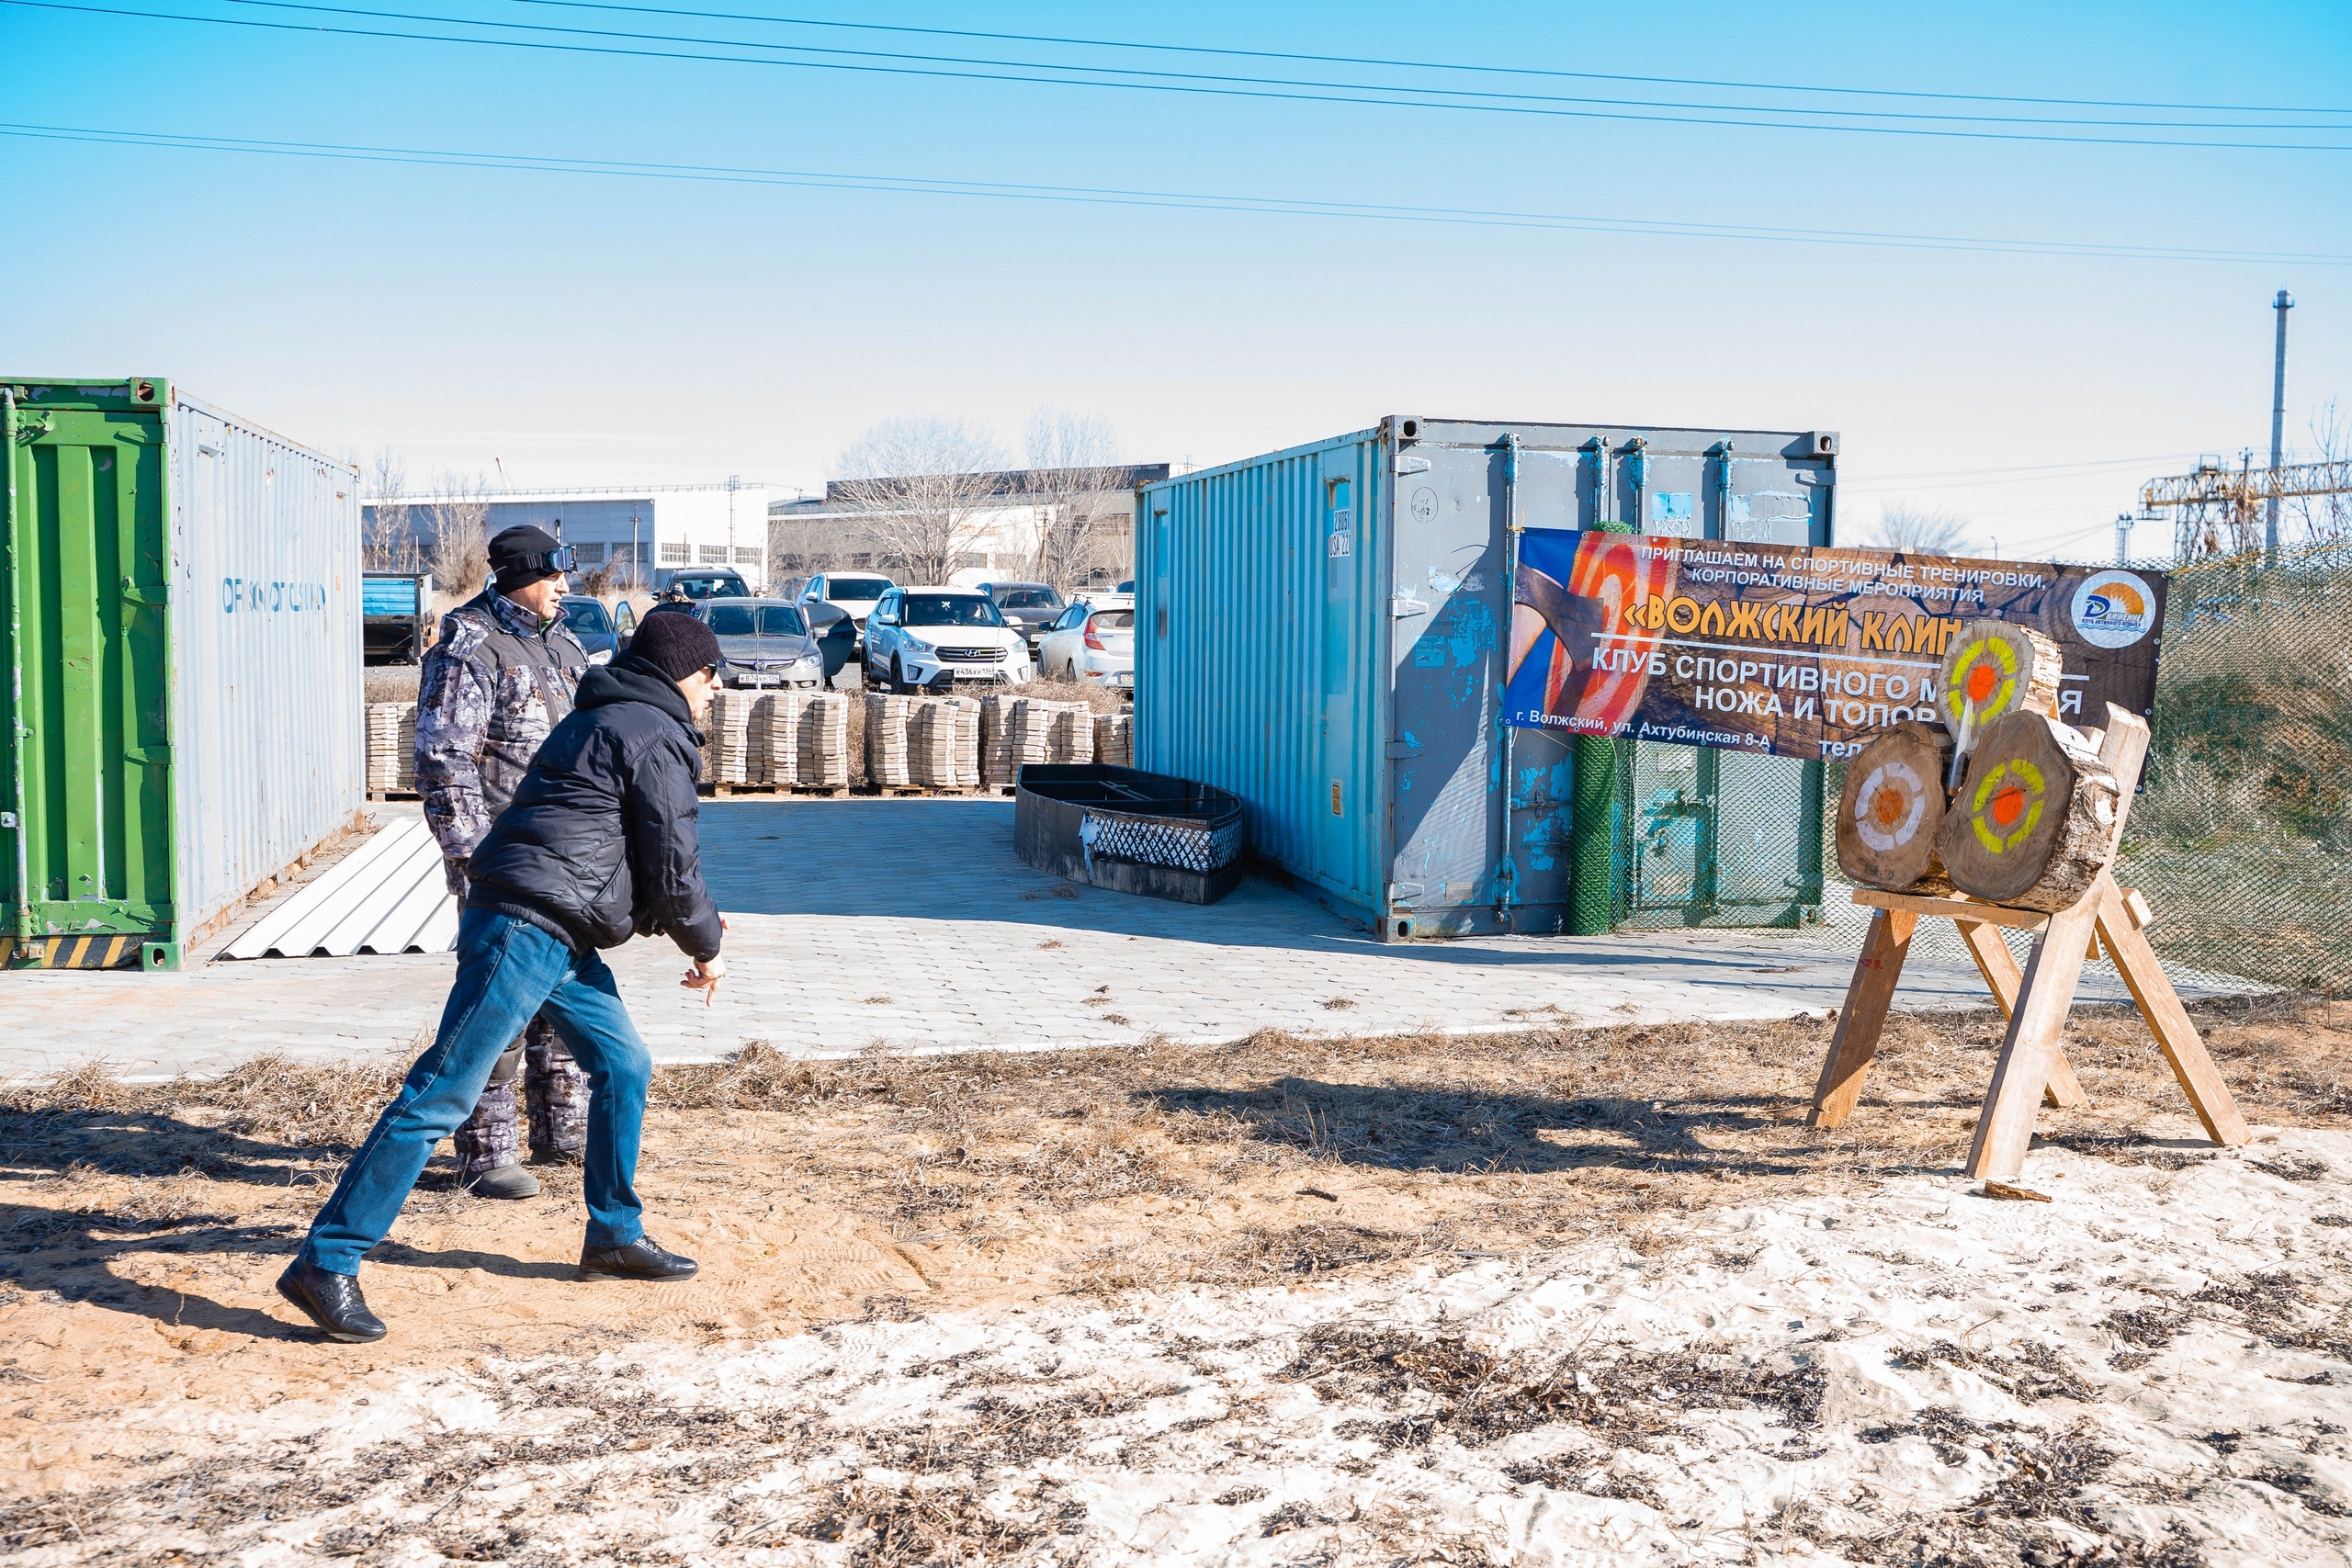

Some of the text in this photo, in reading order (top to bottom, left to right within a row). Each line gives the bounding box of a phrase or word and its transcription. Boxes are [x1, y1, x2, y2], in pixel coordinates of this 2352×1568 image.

[1641, 547, 2047, 592] ПРИГЛАШАЕМ НА СПОРТИВНЫЕ ТРЕНИРОВКИ,
[1691, 568, 1984, 603] КОРПОРАТИВНЫЕ МЕРОПРИЯТИЯ
[1623, 592, 1964, 656] «ВОЛЖСКИЙ КЛИН
[1591, 648, 1667, 676] КЛУБ
[1676, 655, 1909, 701] СПОРТИВНОГО
[1695, 685, 1937, 728] НОЖА И ТОПОР
[1516, 710, 1771, 749] г. Волжский, ул. Ахтубинская 8-А
